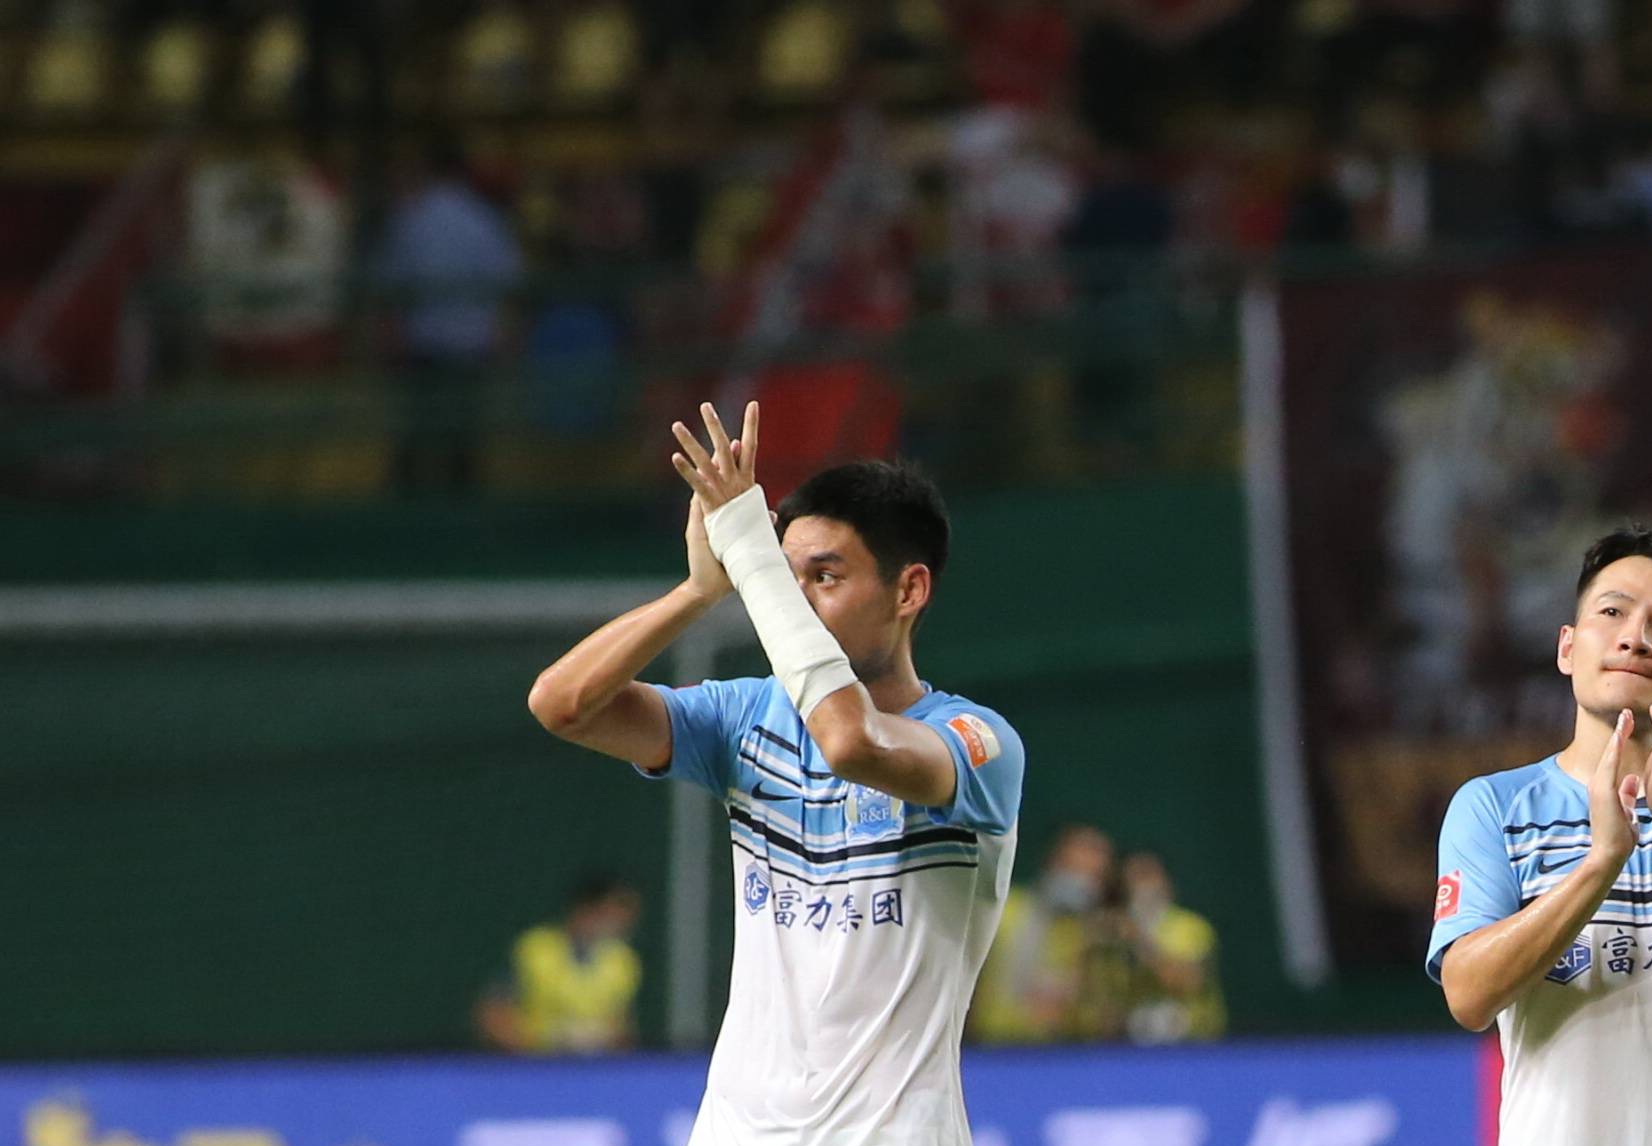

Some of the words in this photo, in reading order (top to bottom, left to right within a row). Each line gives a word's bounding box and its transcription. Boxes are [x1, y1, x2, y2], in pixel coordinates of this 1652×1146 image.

[858, 808, 891, 824] R&F
[773, 880, 904, 933] 富力集团
